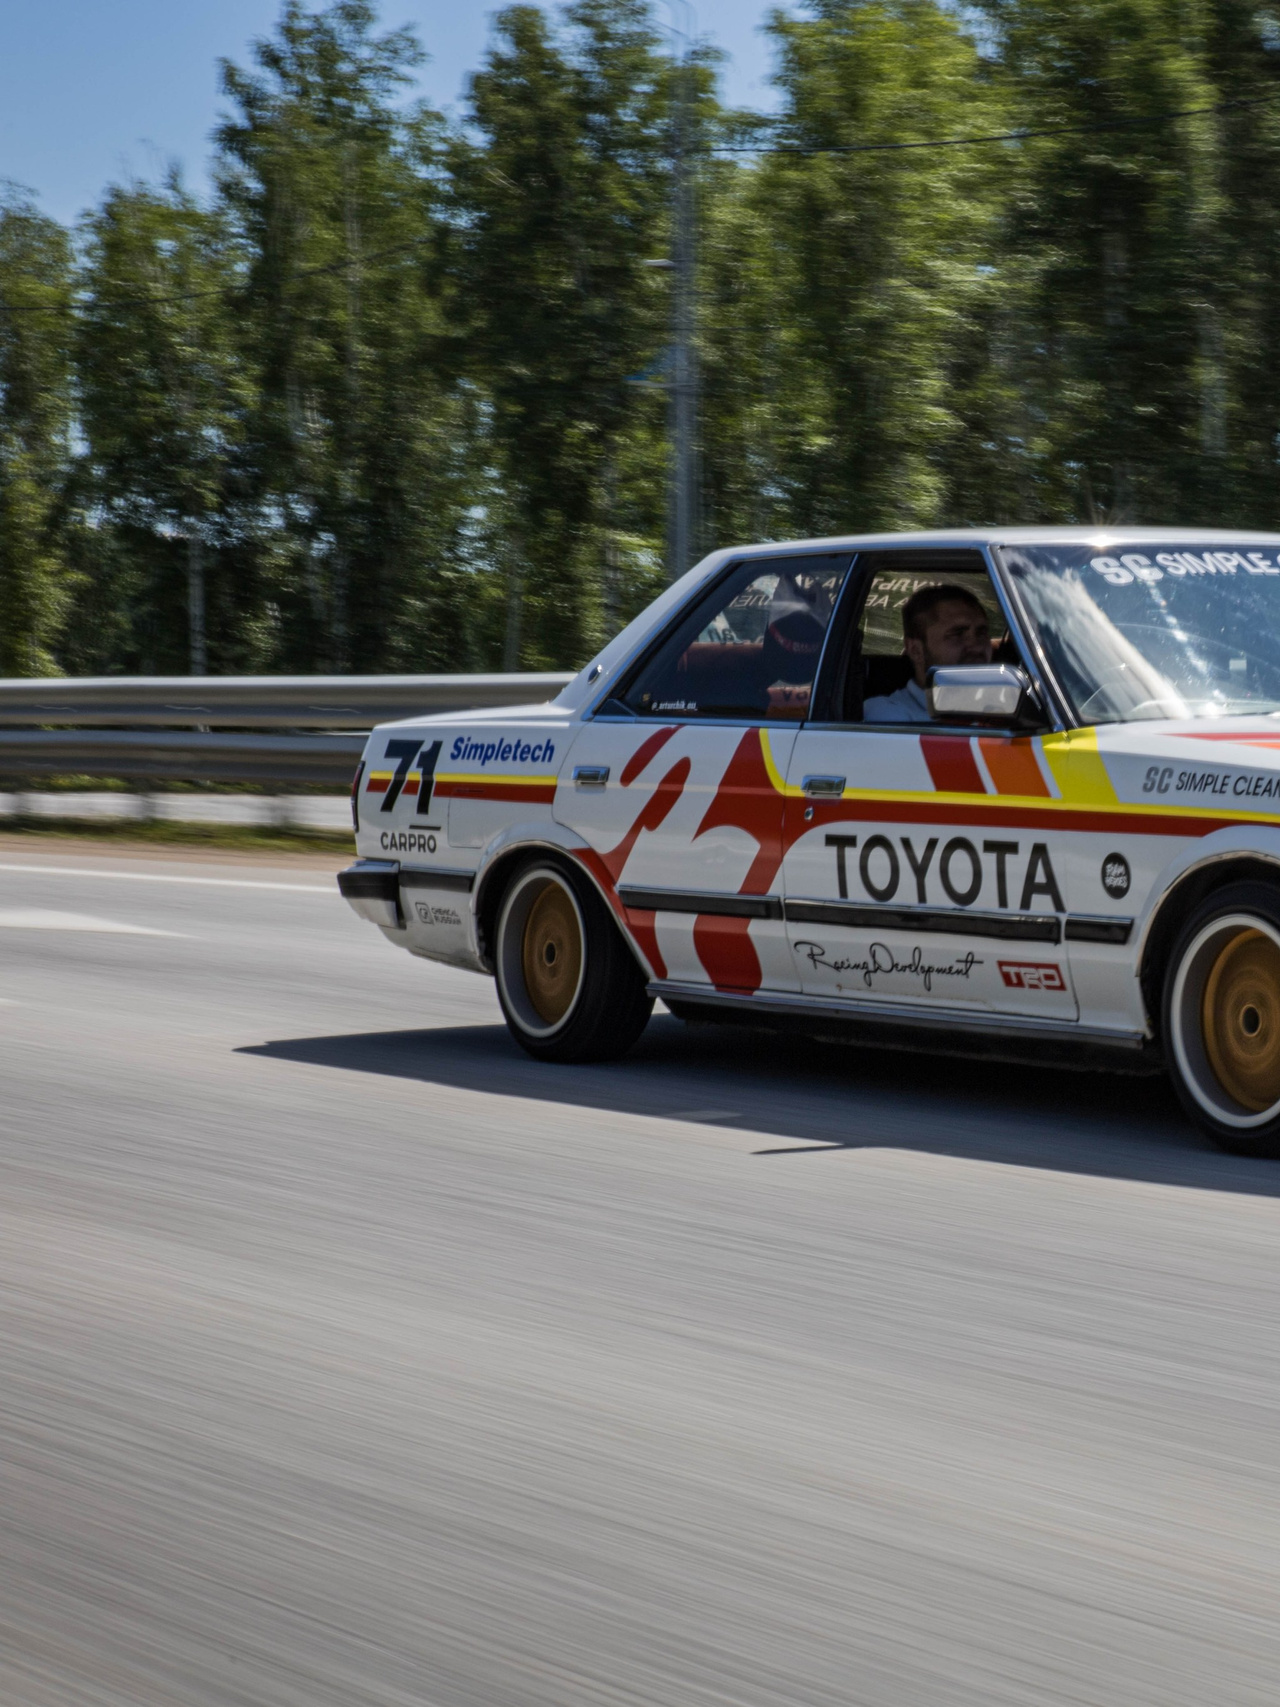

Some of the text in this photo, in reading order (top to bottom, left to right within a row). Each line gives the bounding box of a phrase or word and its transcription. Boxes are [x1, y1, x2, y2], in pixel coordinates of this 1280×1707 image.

[1090, 553, 1163, 587] SC
[1155, 551, 1280, 578] SIMPLE
[450, 737, 555, 766] Simpletech
[380, 739, 443, 815] 71
[1142, 766, 1174, 794] SC
[1175, 771, 1232, 794] SIMPLE
[380, 831, 438, 854] CARPRO
[825, 833, 1067, 914] TOYOTA
[793, 941, 880, 988] Racing
[1000, 964, 1064, 989] TRD
